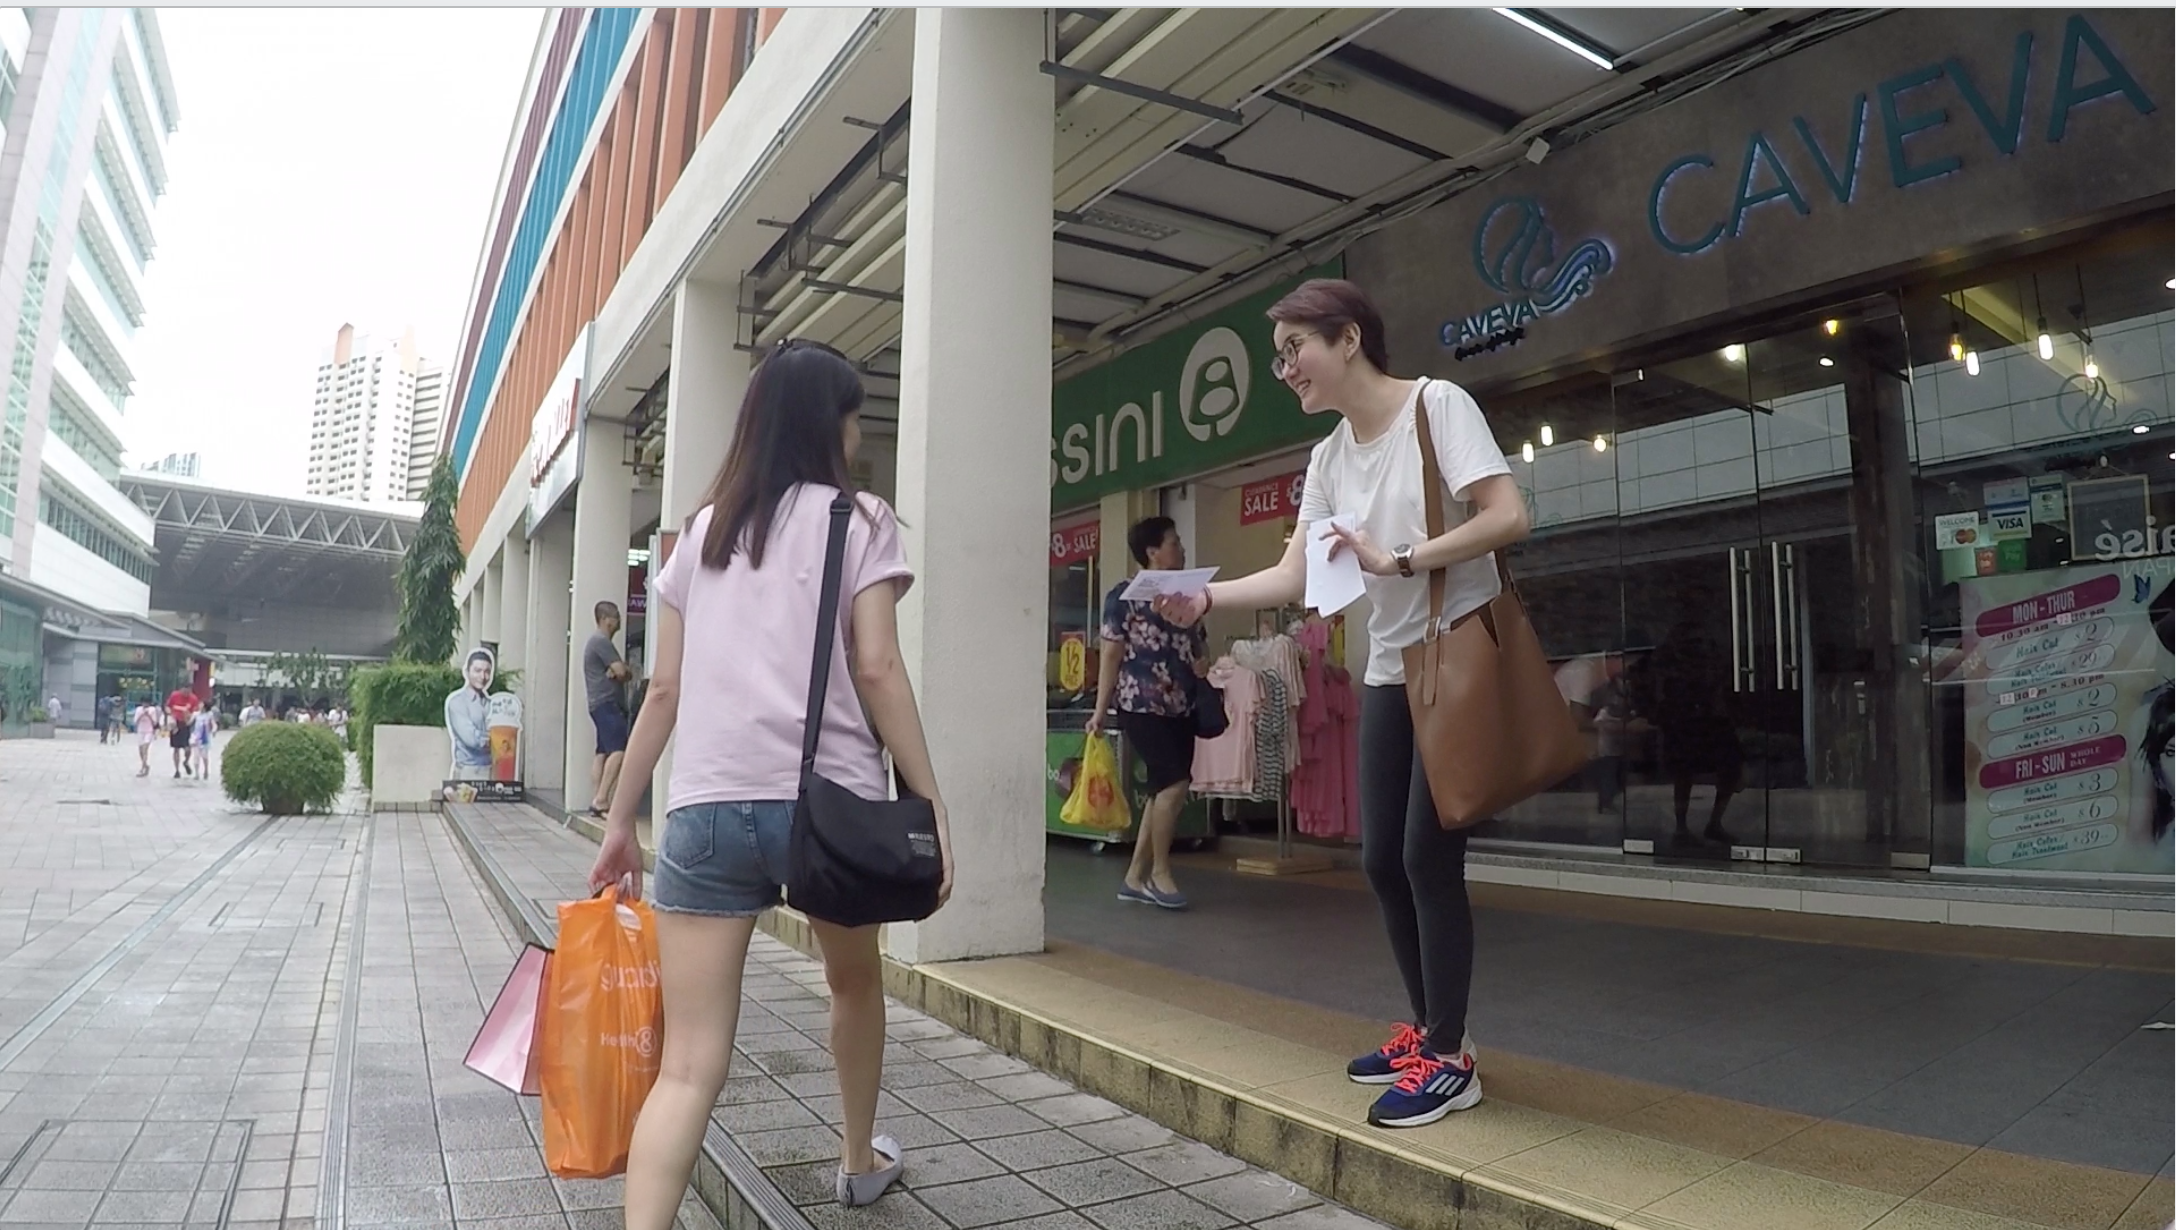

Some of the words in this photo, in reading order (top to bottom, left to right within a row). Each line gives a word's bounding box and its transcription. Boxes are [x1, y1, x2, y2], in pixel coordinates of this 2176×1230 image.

[1648, 12, 2158, 255] CAVEVA
[1439, 296, 1541, 346] CAVEVA
[1243, 491, 1280, 517] SALE
[1939, 515, 1975, 527] WELCOME
[1996, 517, 2024, 530] VISA
[1073, 532, 1097, 554] SALE
[2012, 600, 2038, 624] MON
[2046, 590, 2076, 615] THUR
[2015, 761, 2034, 780] FRI
[2042, 751, 2066, 773] SUN
